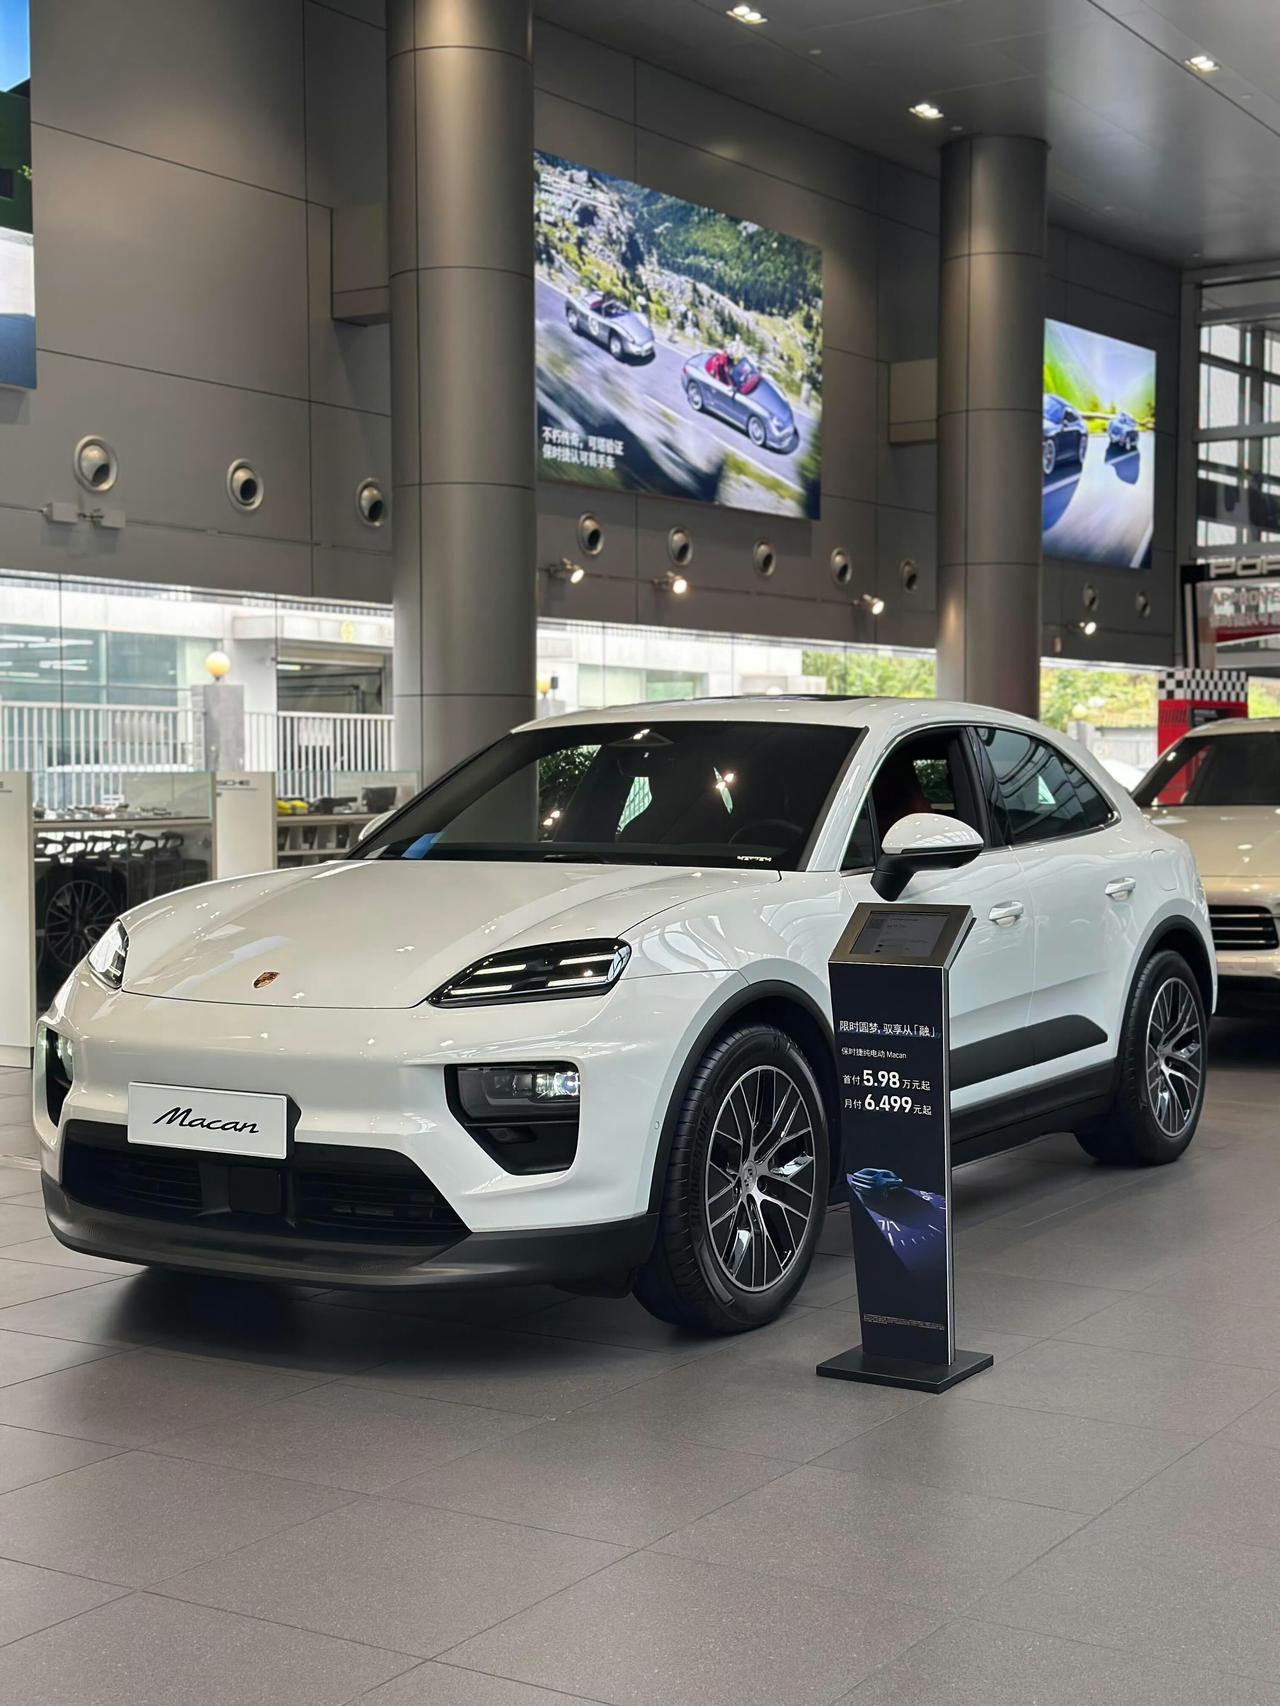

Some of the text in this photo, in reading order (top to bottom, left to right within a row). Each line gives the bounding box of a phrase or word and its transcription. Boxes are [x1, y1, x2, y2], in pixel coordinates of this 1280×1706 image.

[841, 1047, 907, 1059] 保时捷纯电动 Macan
[863, 1069, 900, 1089] 5.98
[864, 1093, 912, 1113] 6.499
[152, 1106, 259, 1134] Macan
